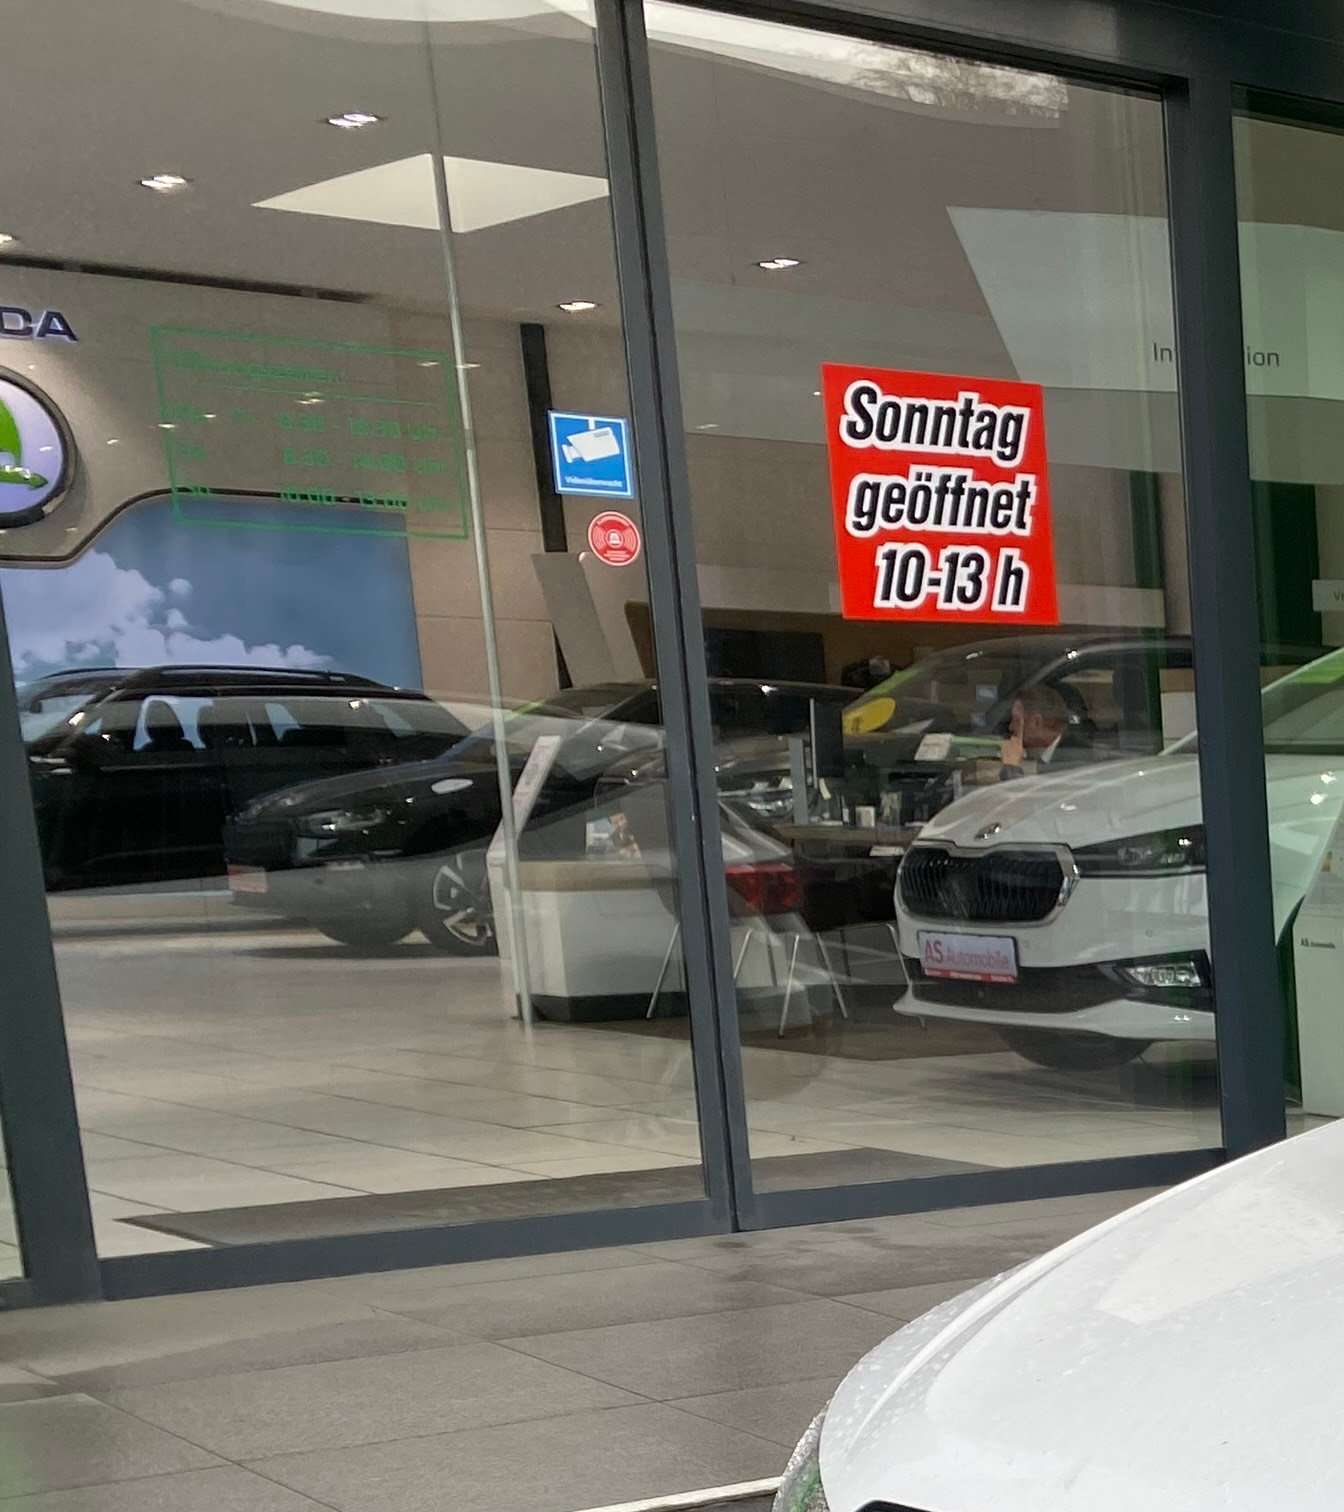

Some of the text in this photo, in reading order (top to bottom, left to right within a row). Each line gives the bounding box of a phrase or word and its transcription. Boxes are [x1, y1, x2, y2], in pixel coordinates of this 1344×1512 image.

[845, 384, 1026, 463] Sonntag
[850, 470, 1033, 533] geöffnet
[879, 548, 1025, 607] 10-13 h
